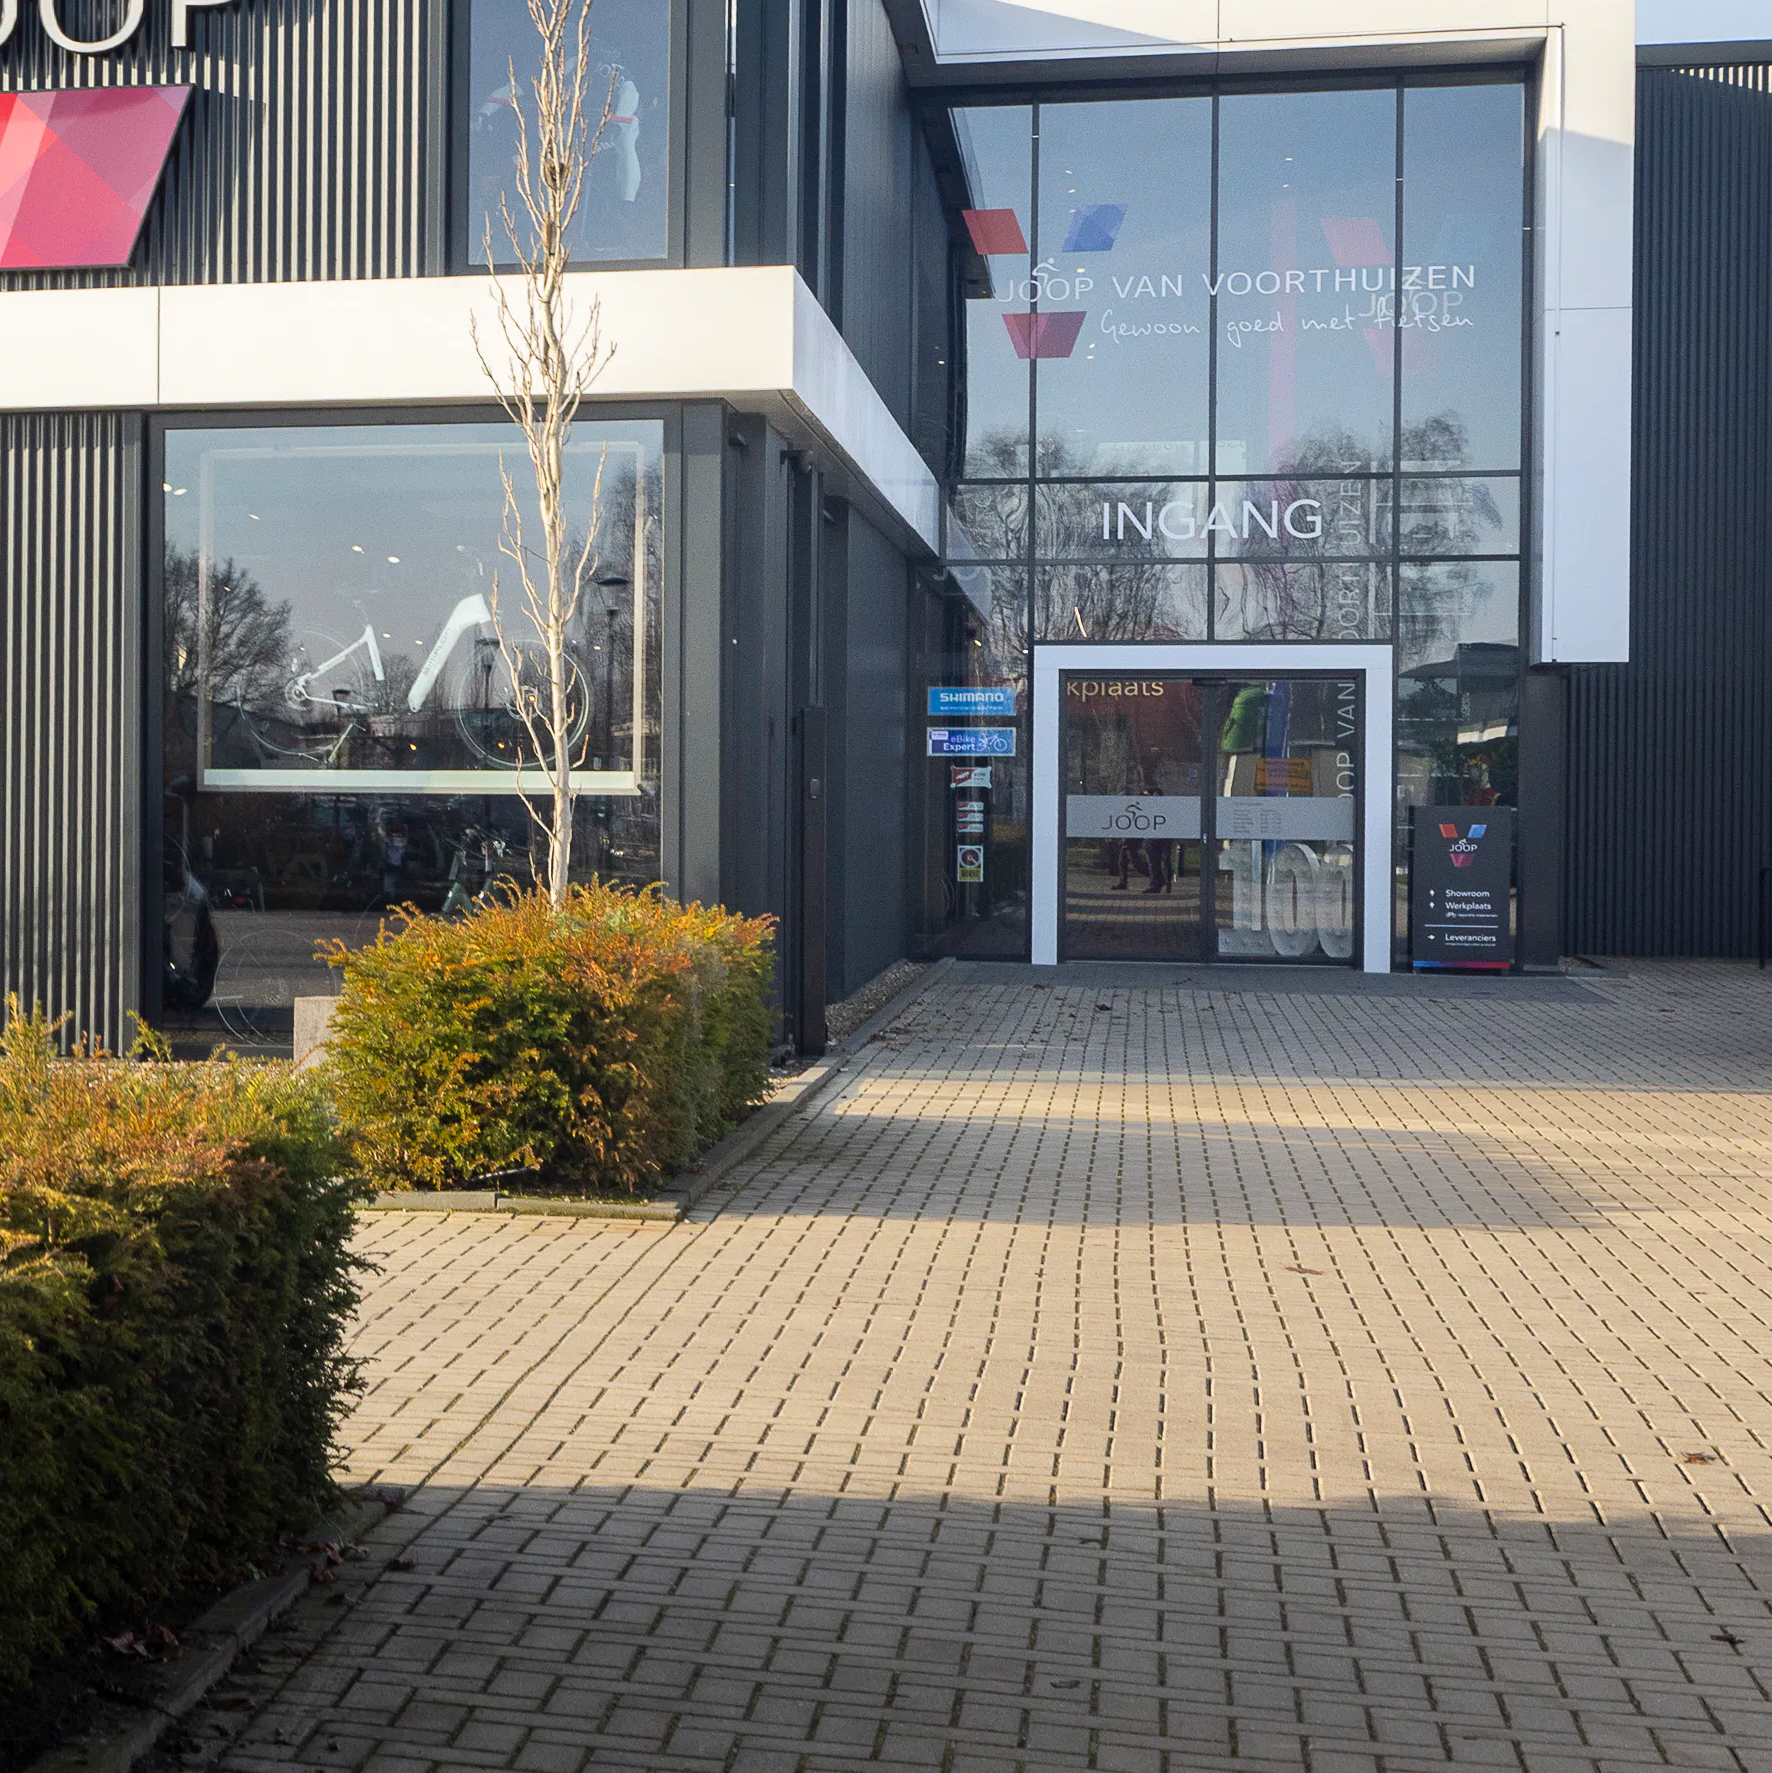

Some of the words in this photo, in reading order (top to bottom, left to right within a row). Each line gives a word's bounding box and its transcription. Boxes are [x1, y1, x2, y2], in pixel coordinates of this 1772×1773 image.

[998, 278, 1094, 303] JOOP
[1112, 274, 1183, 299] VAN
[1201, 265, 1475, 296] VOORTHUIZEN
[1100, 309, 1200, 344] Gewoon
[1227, 311, 1285, 348] goed
[1303, 304, 1355, 330] met
[1374, 296, 1474, 332] fietsen
[1103, 498, 1323, 540] INGANG
[940, 692, 1005, 703] SHIMANO
[950, 734, 976, 744] eBike
[943, 742, 976, 752] Expert
[1101, 814, 1167, 830] JOOP
[1449, 844, 1478, 852] JOOP
[1445, 889, 1490, 898] Showroom
[1445, 901, 1492, 911] Werkplaats
[1445, 933, 1497, 942] Leveranciers
